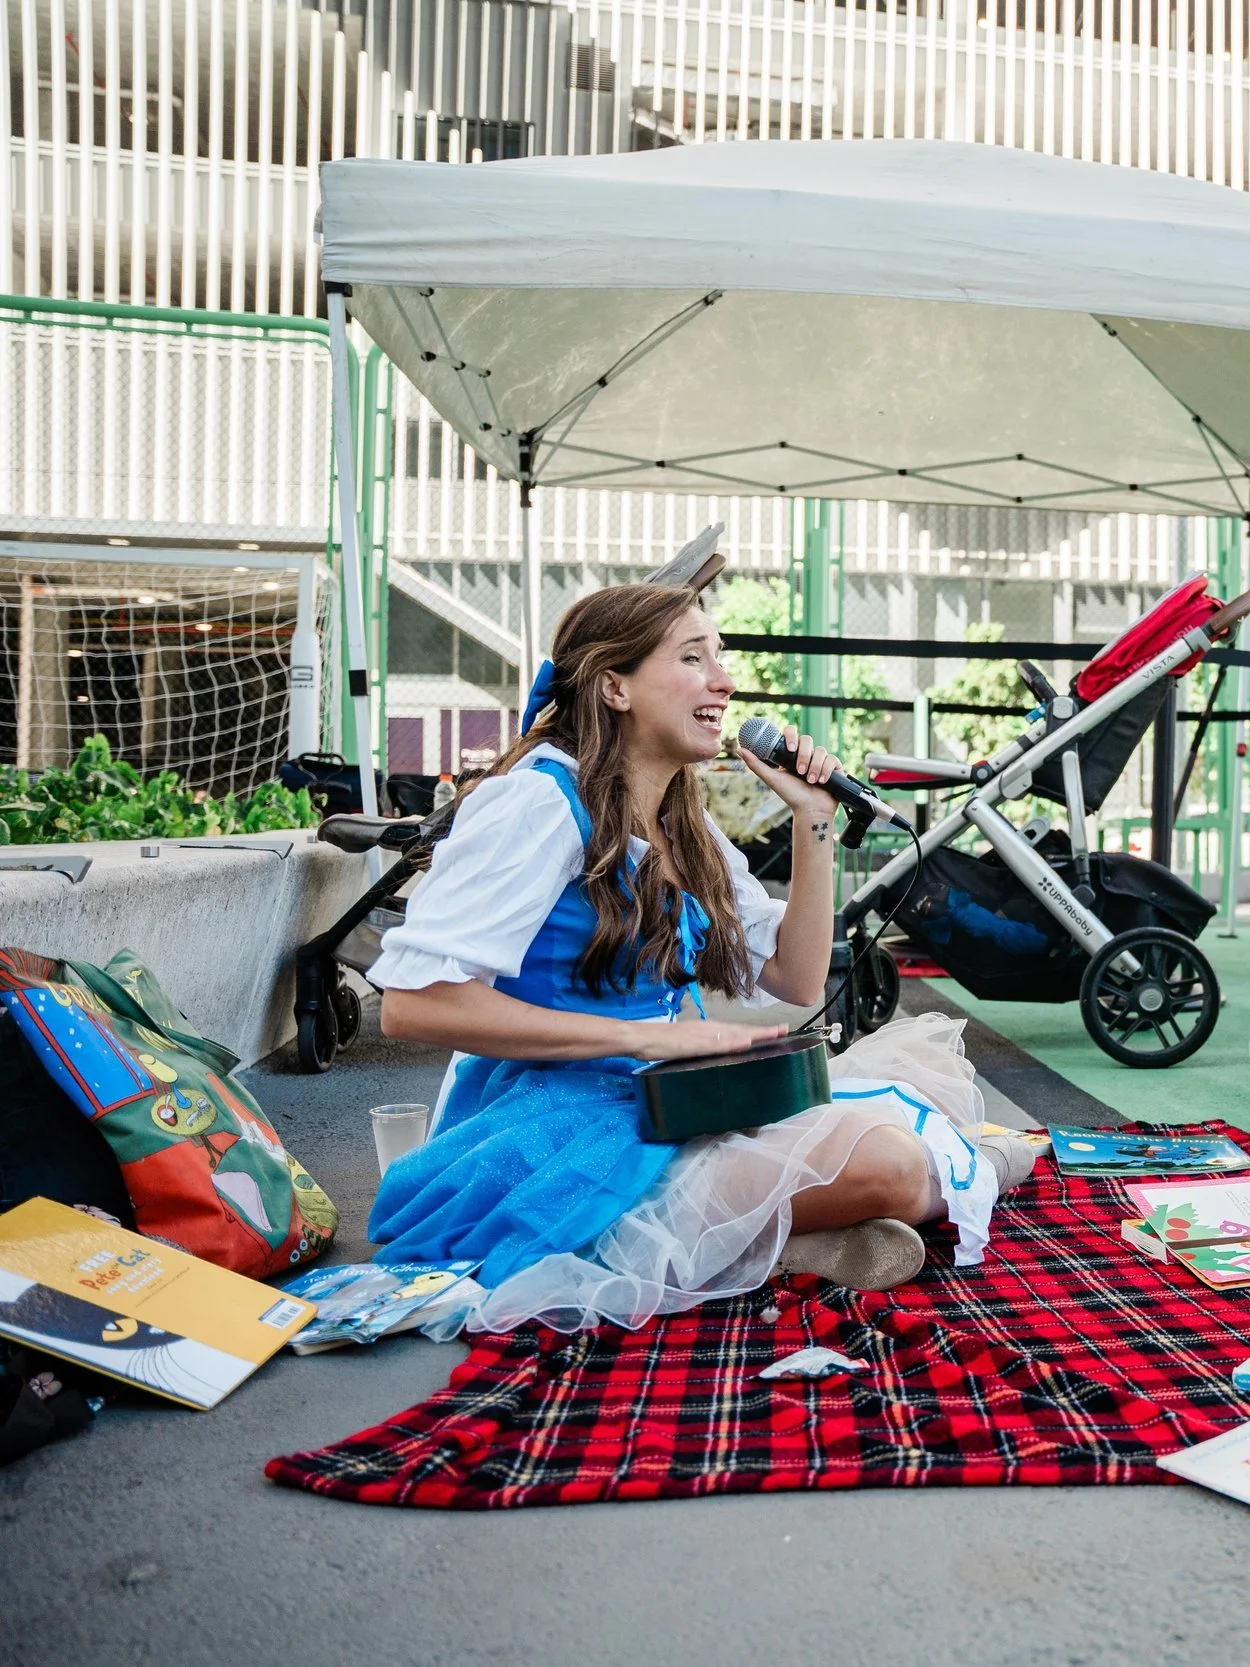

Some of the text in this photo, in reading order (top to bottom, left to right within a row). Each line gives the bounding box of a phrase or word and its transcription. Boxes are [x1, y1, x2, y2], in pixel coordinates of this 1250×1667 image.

[1142, 655, 1175, 679] VISTA
[1057, 1130, 1108, 1140] Room
[1170, 1137, 1224, 1145] Broom
[78, 1269, 122, 1291] Pete
[116, 1248, 151, 1267] Cat
[389, 1262, 437, 1274] Ghosts
